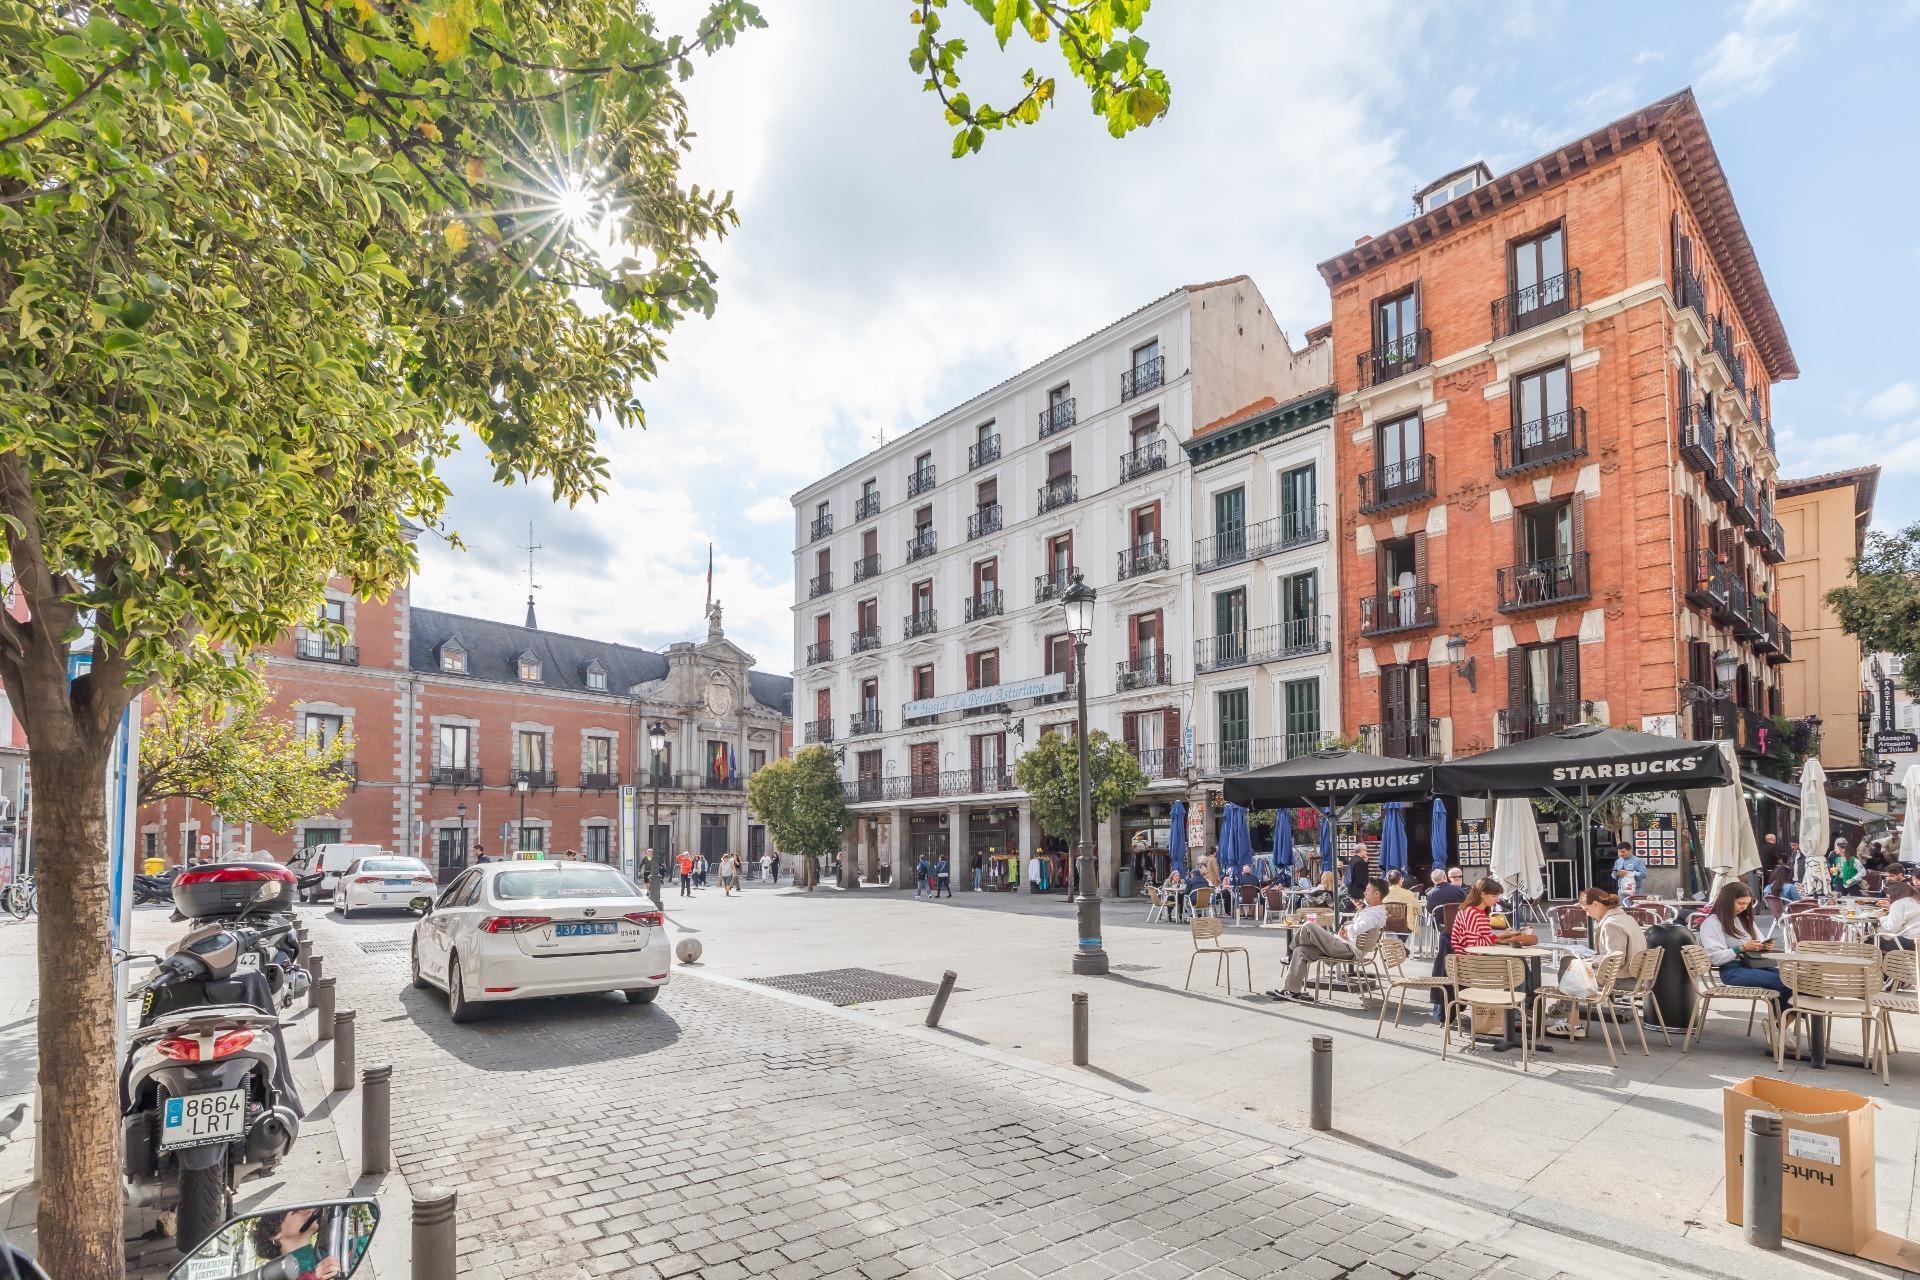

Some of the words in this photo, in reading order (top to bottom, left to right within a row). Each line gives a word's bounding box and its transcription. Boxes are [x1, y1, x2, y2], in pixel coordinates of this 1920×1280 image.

[919, 700, 949, 714] Hostal
[968, 689, 993, 707] Perla
[994, 682, 1045, 702] Asturiana
[1553, 757, 1698, 781] STARBUCKS
[1315, 774, 1421, 791] STARBUCKS
[186, 1093, 241, 1118] 8664
[170, 1116, 179, 1124] E
[192, 1112, 235, 1136] LRT
